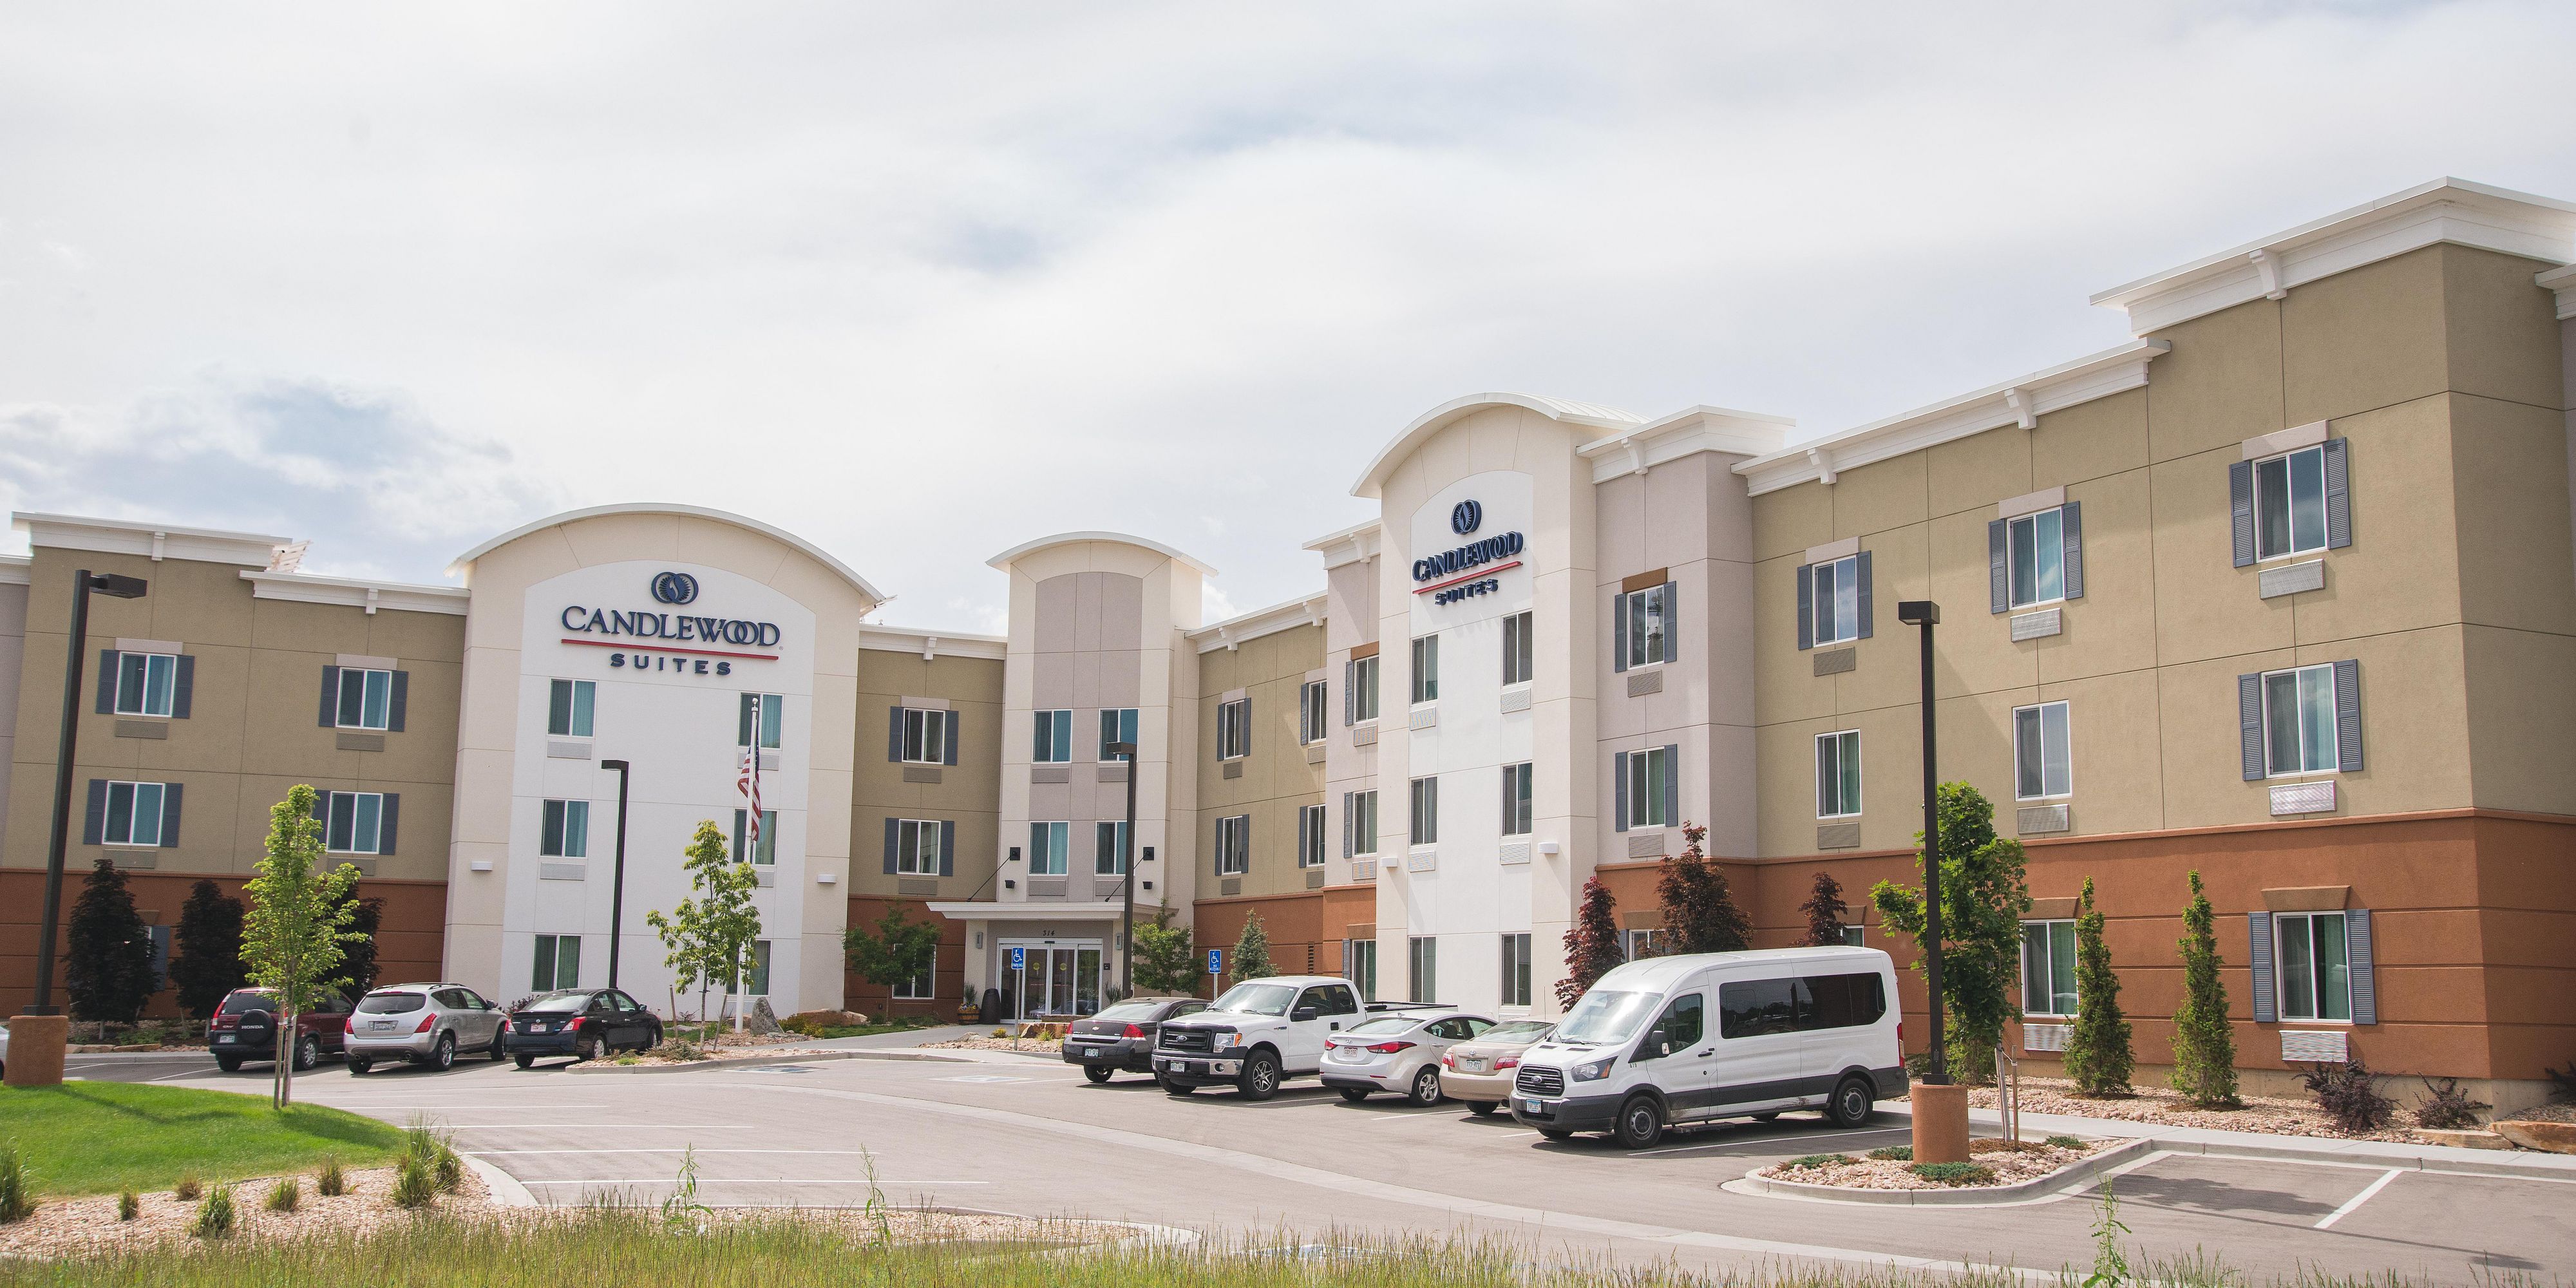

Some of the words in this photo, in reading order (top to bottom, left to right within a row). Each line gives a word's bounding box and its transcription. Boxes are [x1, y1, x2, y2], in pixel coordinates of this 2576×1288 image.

[1412, 531, 1523, 582] CANDLEWOOD
[1435, 579, 1499, 605] SUITES
[561, 605, 781, 647] CANDLEWOOD
[611, 653, 732, 676] SUITES
